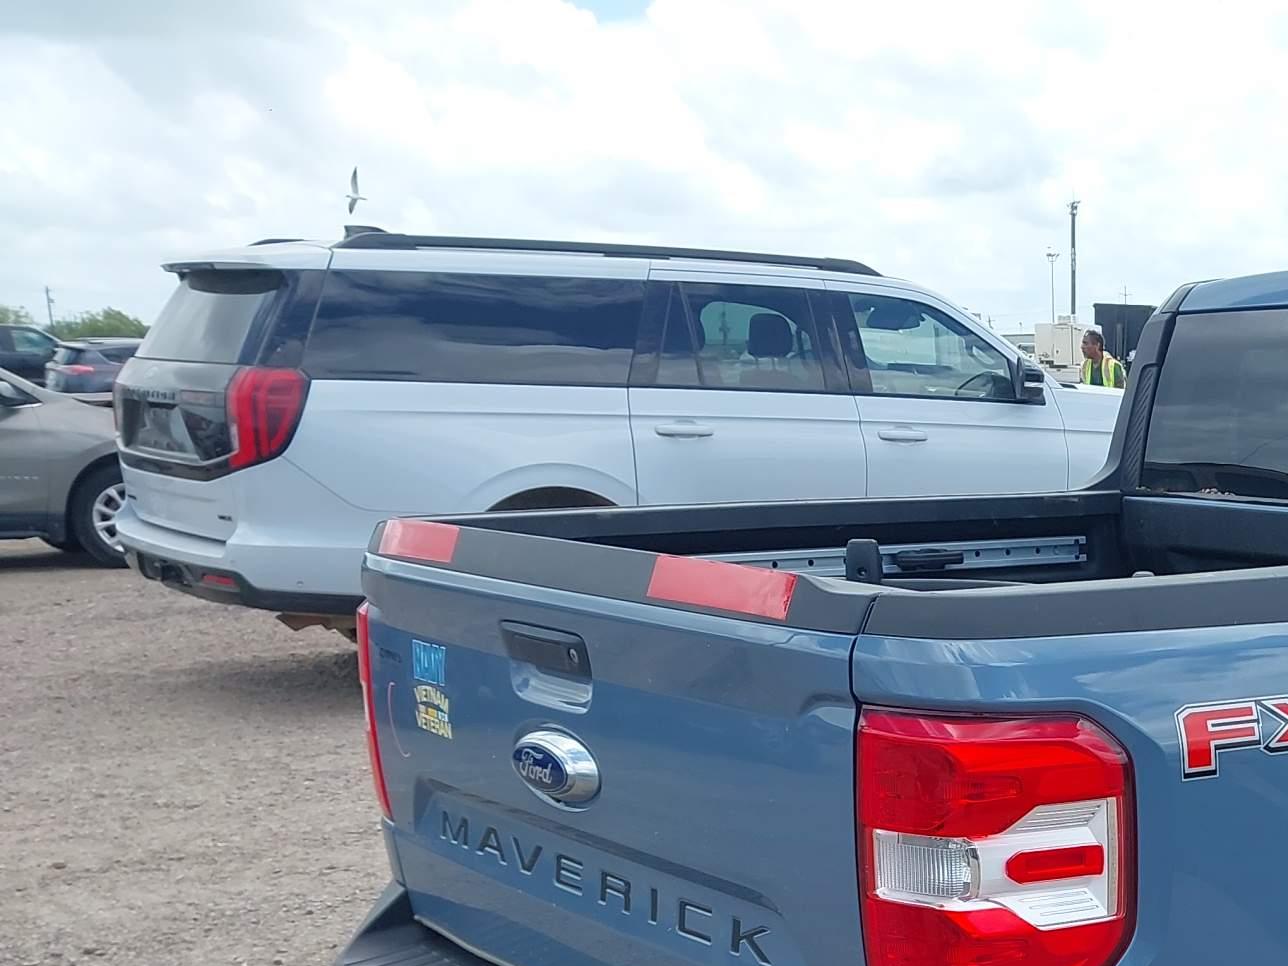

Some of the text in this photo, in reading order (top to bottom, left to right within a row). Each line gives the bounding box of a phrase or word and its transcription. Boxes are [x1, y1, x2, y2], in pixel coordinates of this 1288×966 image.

[414, 685, 449, 714] VIETNAM
[416, 710, 453, 739] VETERAN
[519, 748, 553, 784] Ford
[440, 810, 772, 966] MAVERICK
